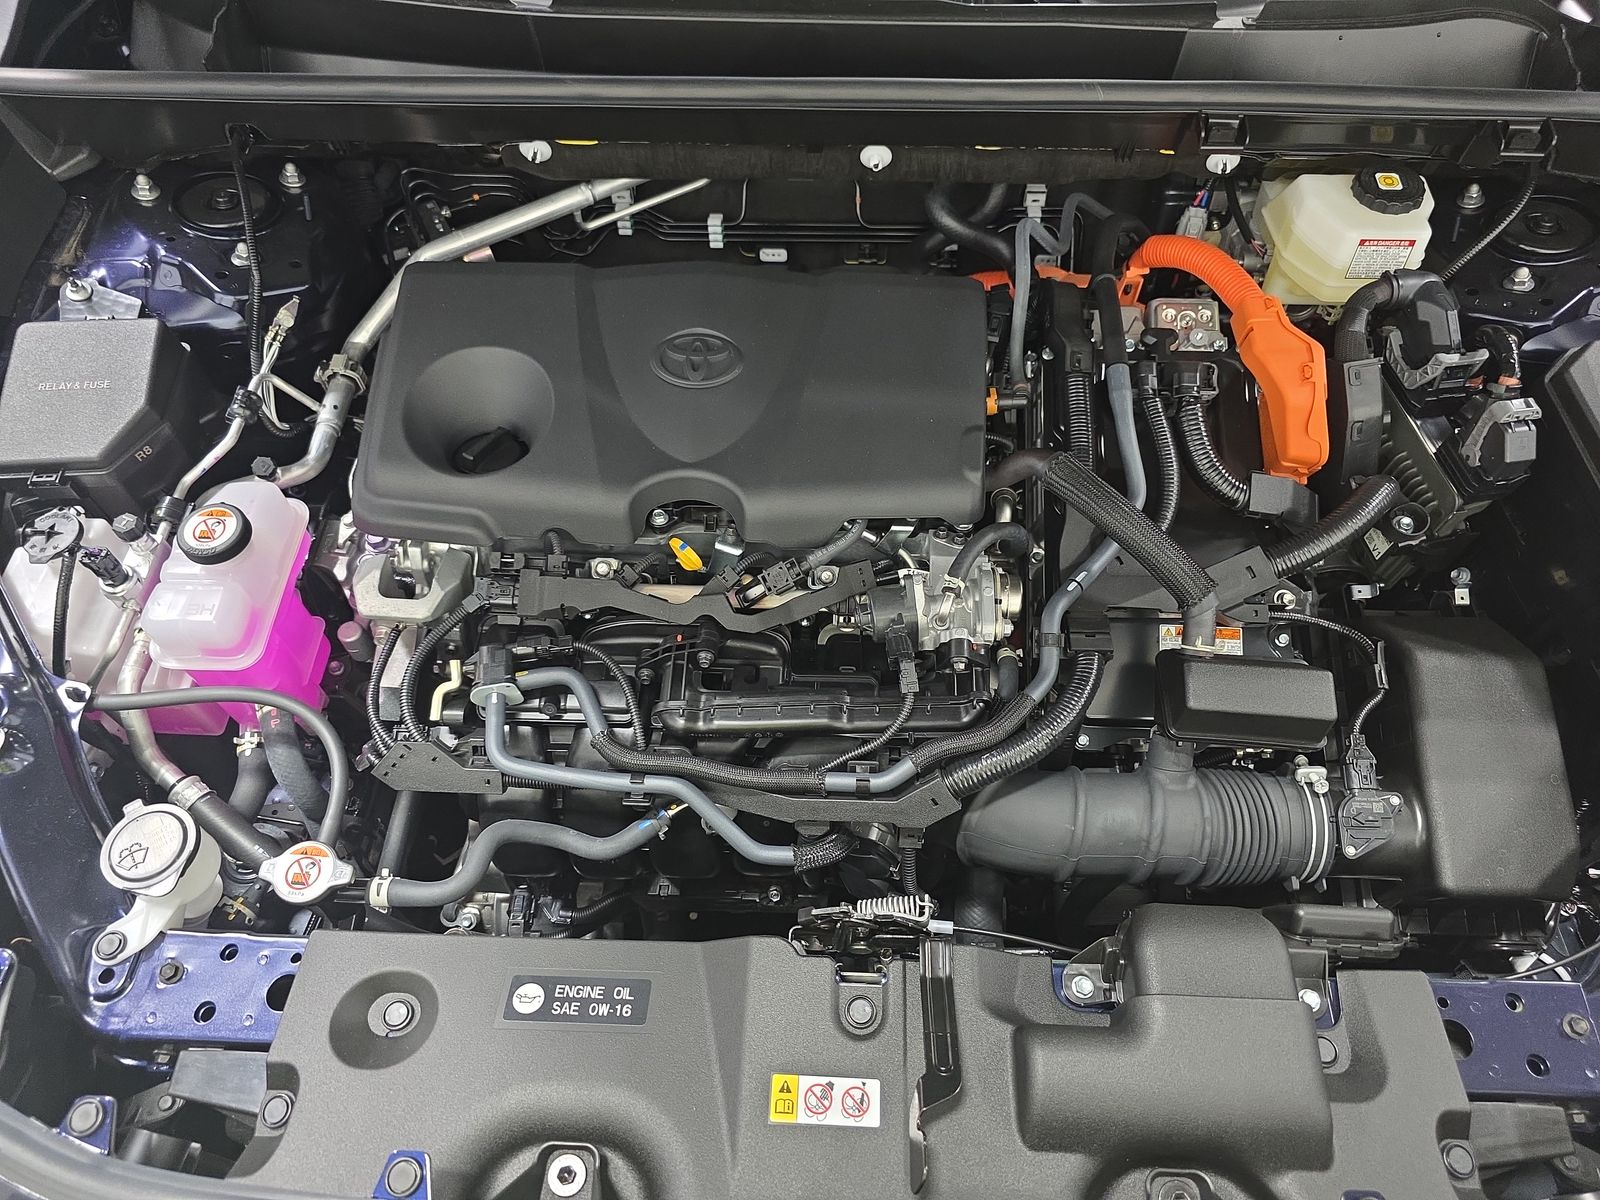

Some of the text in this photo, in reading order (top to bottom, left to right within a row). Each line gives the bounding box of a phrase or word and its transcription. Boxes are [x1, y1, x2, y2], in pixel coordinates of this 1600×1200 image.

[38, 380, 111, 391] RELAY & FUSE
[134, 445, 153, 462] R8
[554, 984, 635, 1000] ENGINE OIL
[551, 1001, 632, 1017] SAE 0W-16
